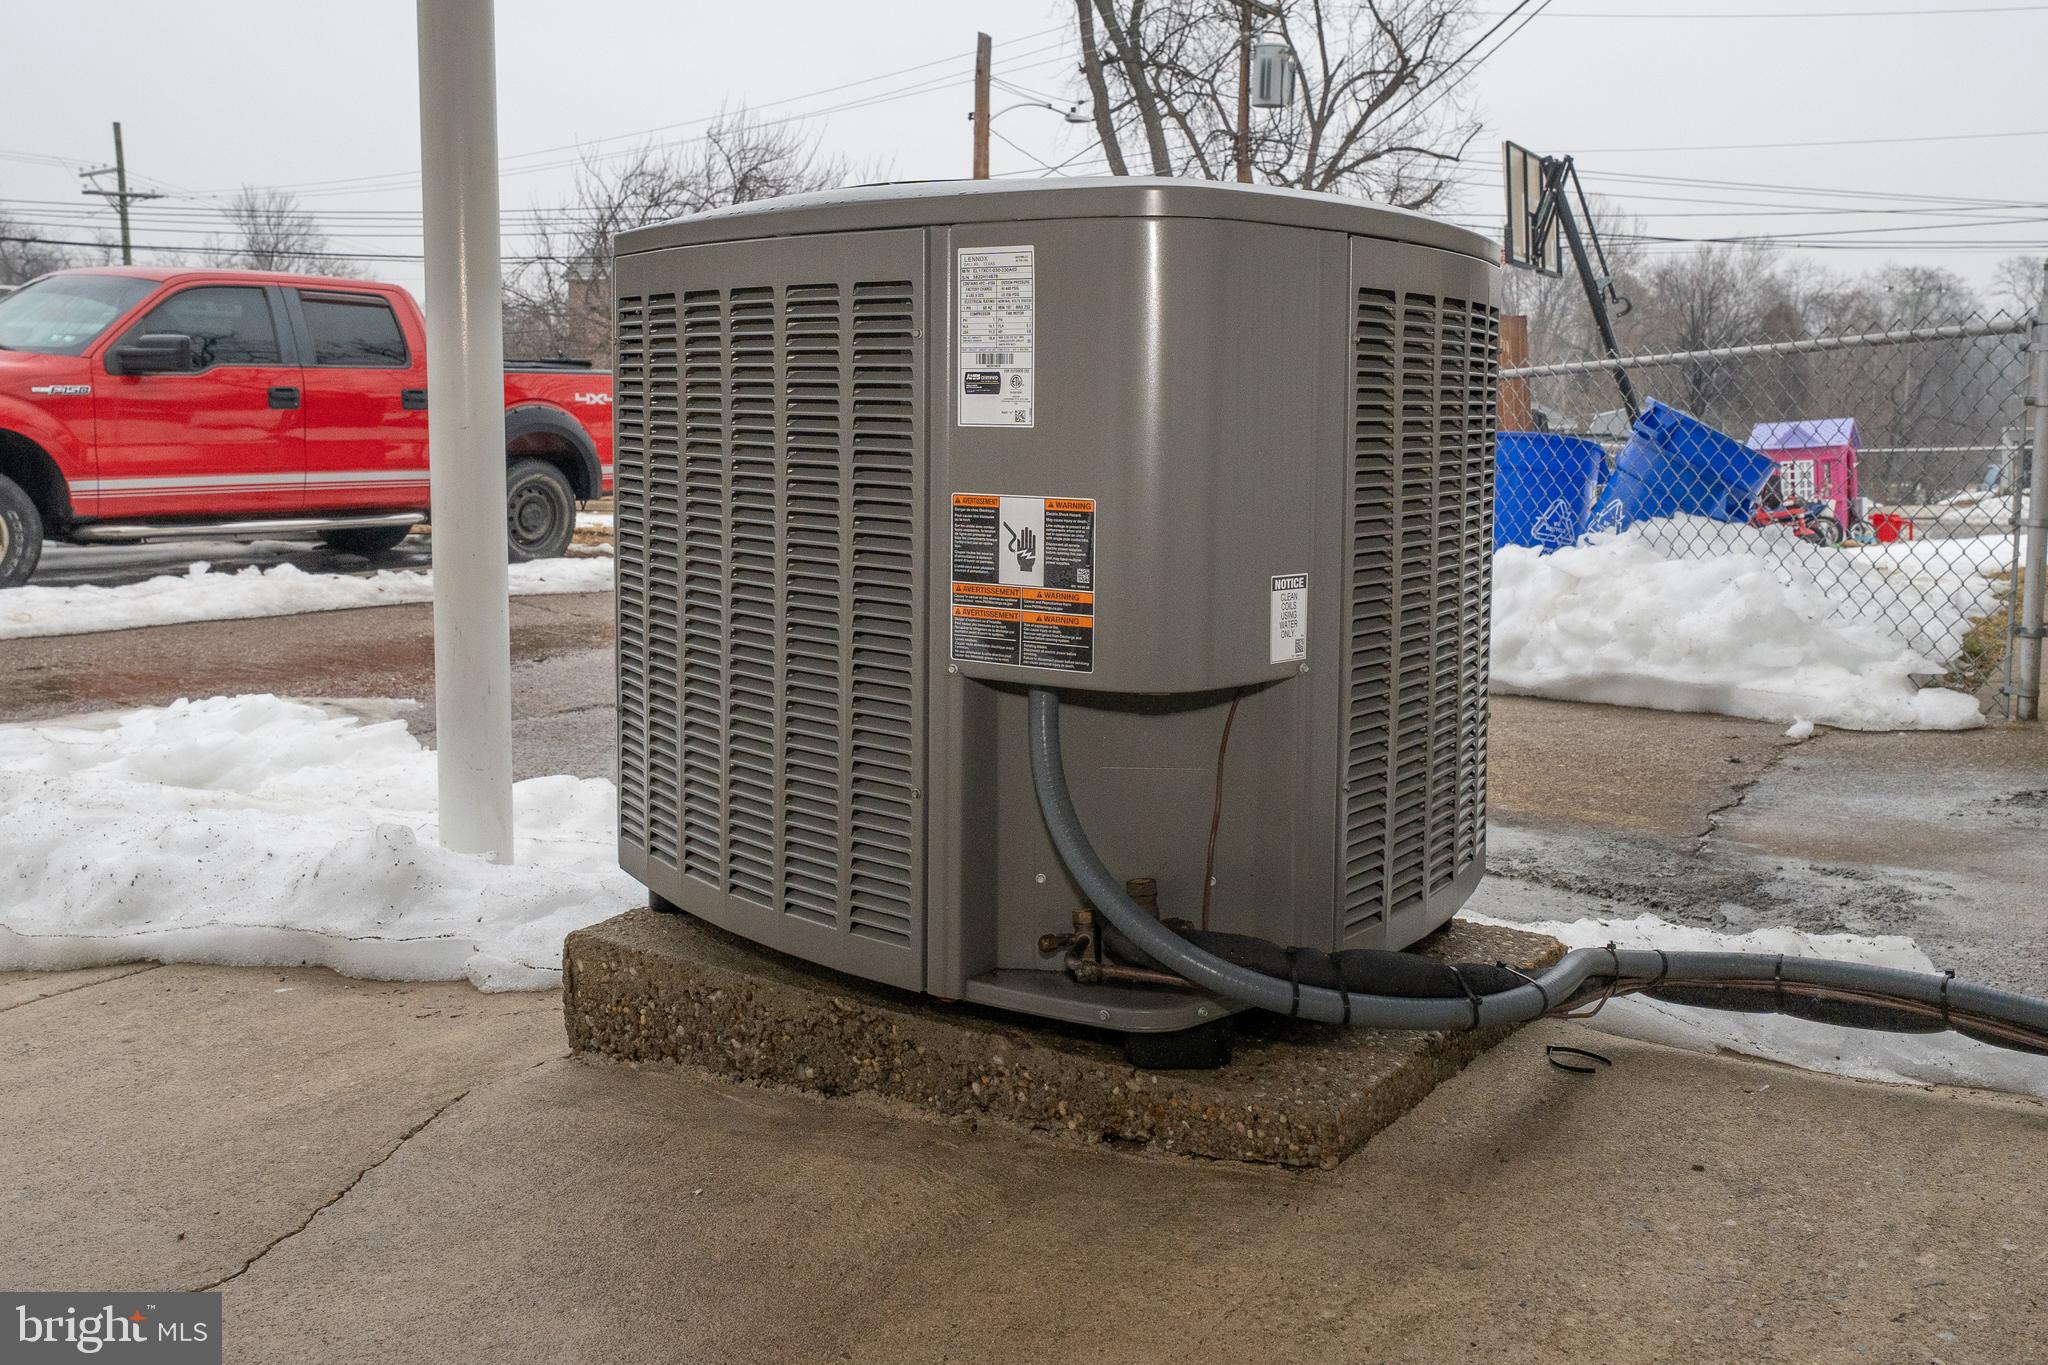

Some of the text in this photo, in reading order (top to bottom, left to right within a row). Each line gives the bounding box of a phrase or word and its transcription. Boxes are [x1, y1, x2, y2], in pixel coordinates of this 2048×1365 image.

[1056, 502, 1092, 510] WARNING
[1275, 577, 1304, 590] NOTICE
[963, 586, 1020, 596] AVERTISSEMENT
[1045, 592, 1079, 601] WARNING
[1281, 592, 1298, 601] CLEAN
[1281, 602, 1296, 610] COILS
[963, 609, 1018, 619] AVERTISSEMENT
[1281, 611, 1297, 620] USING
[1044, 616, 1079, 625] WARNING
[1280, 620, 1298, 629] WATER
[1281, 630, 1296, 638] ONLY.
